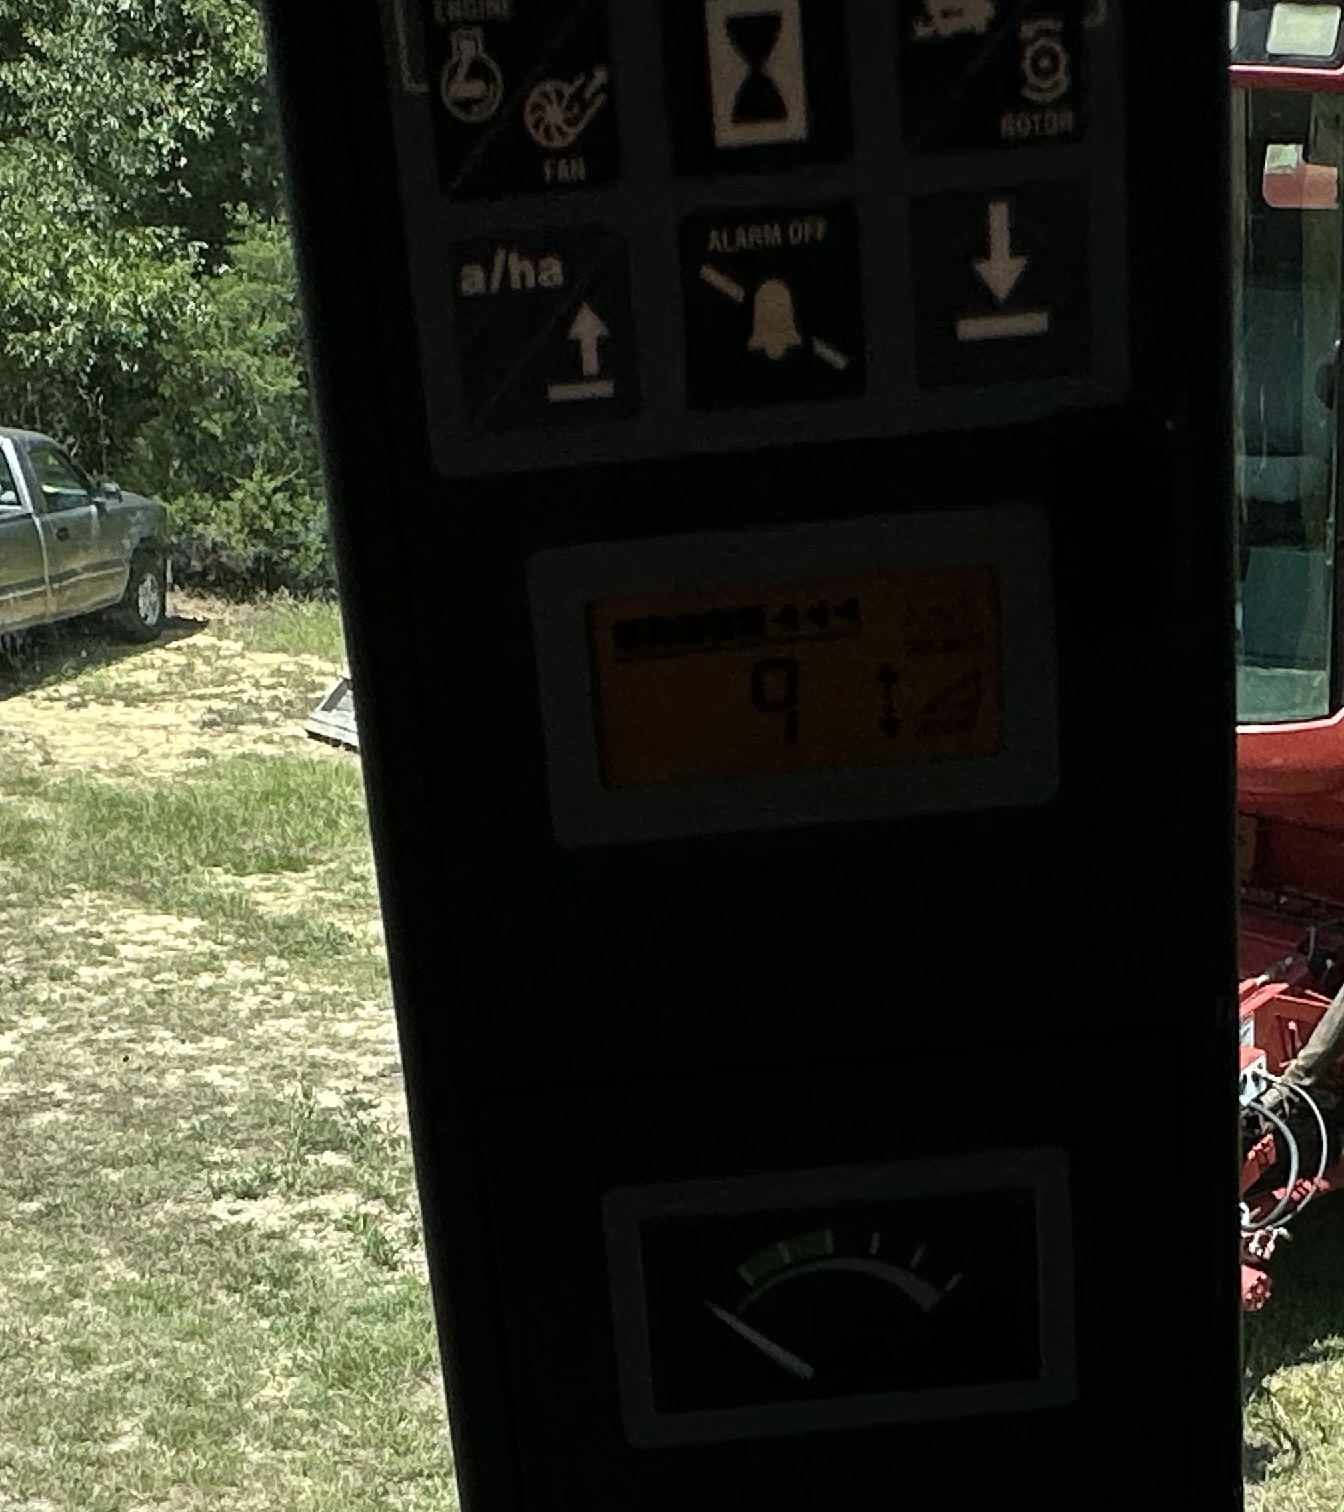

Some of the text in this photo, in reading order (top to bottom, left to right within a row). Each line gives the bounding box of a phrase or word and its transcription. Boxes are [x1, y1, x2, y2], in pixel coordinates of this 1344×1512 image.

[1000, 106, 1074, 141] ROTOR
[541, 153, 587, 184] FAN
[707, 215, 829, 255] ALARM OFF
[459, 247, 564, 298] a/ha
